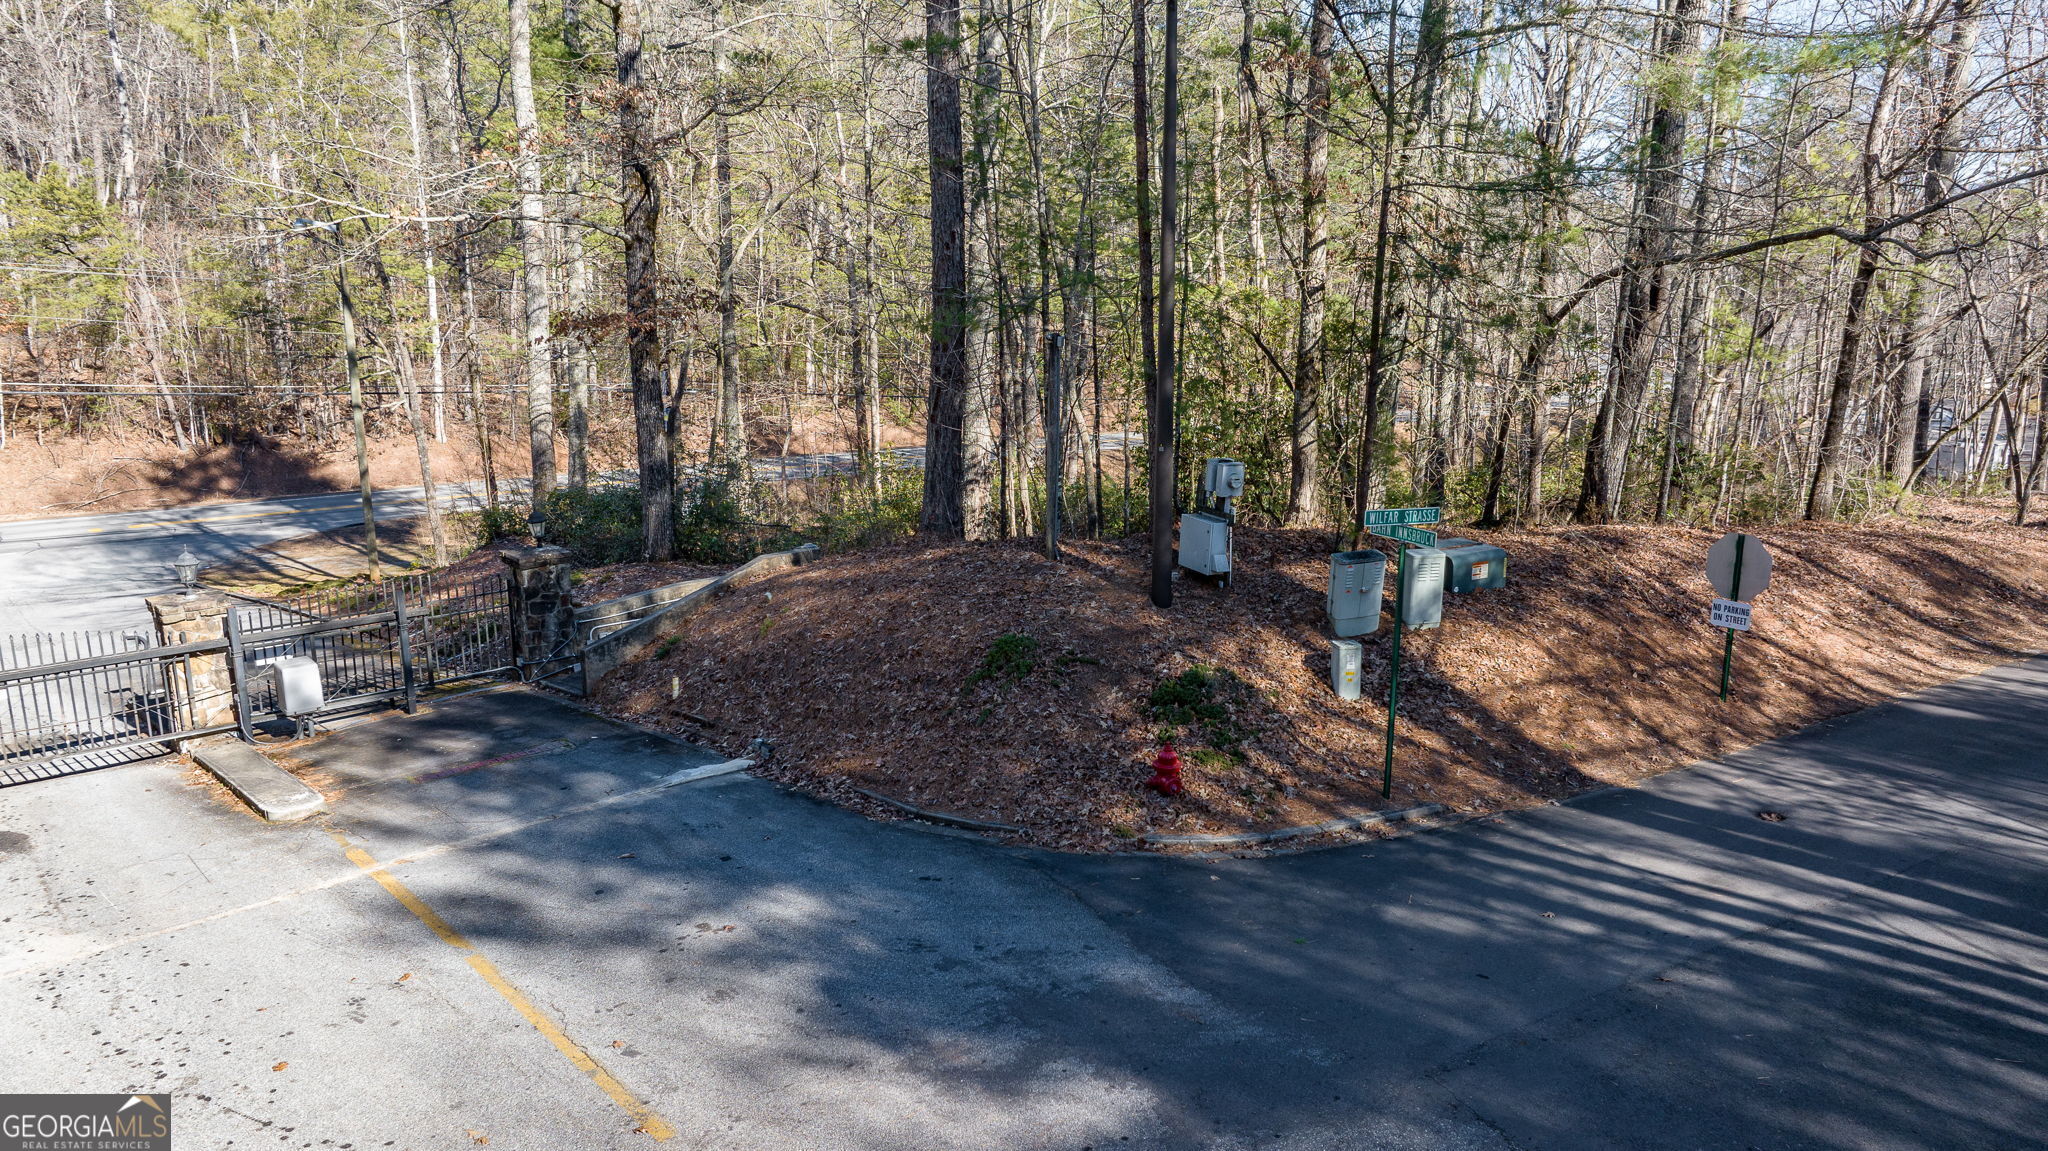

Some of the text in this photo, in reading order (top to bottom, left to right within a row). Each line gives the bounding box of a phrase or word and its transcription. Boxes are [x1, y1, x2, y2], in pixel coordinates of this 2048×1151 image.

[1369, 509, 1437, 524] WILFAR STRASSE
[1395, 526, 1435, 546] INNSBRUCK
[1713, 603, 1750, 617] NO PARKING
[1713, 612, 1747, 626] ON STREET
